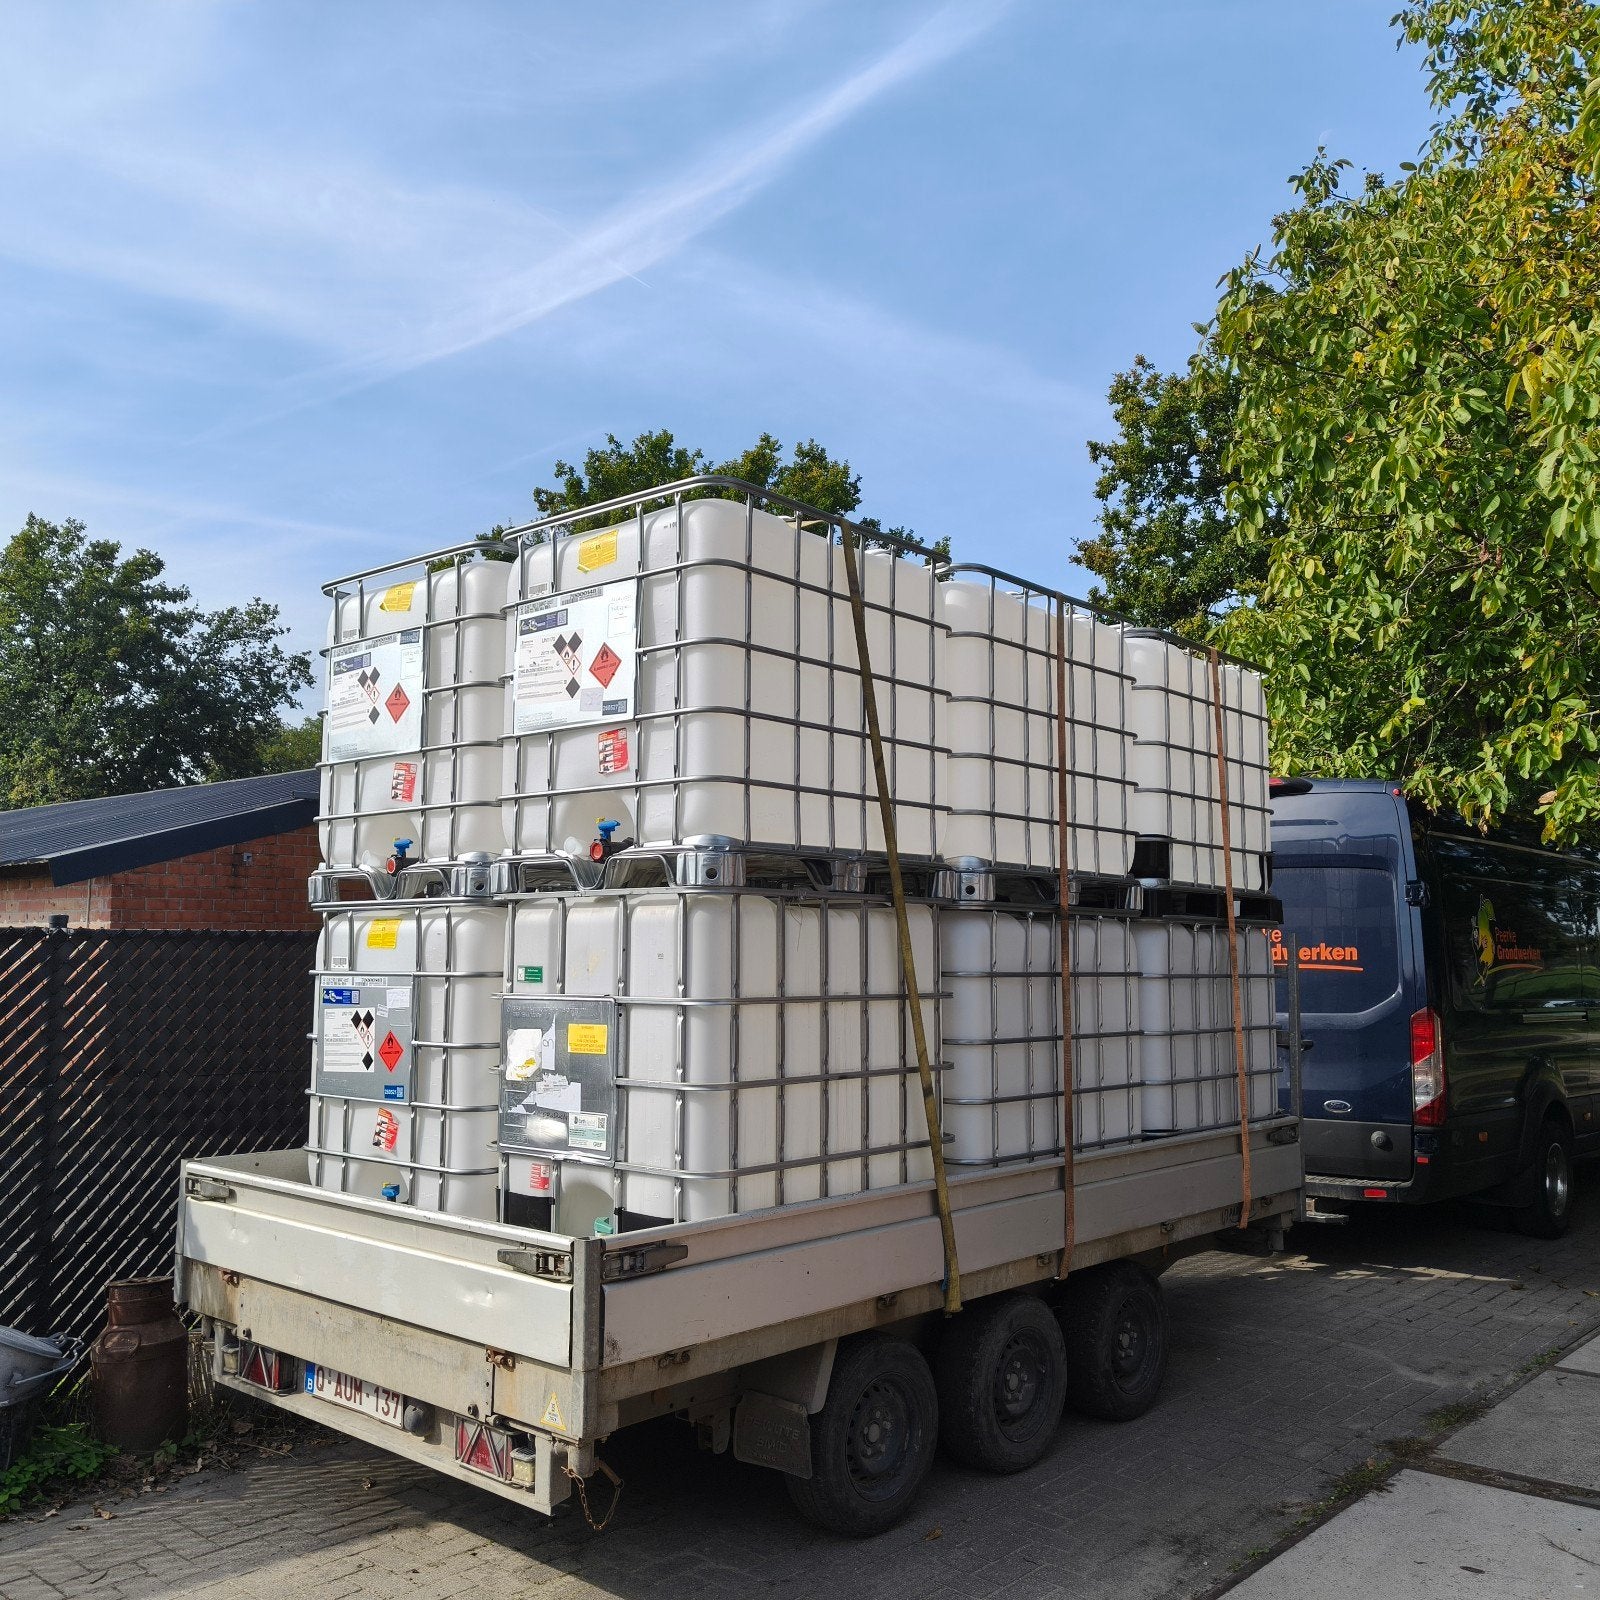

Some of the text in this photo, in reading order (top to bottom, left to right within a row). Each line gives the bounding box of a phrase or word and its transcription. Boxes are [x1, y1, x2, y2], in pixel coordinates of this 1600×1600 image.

[1496, 944, 1542, 960] Grondwerken
[307, 1377, 313, 1390] B
[316, 1366, 401, 1419] Q-AUM-137
